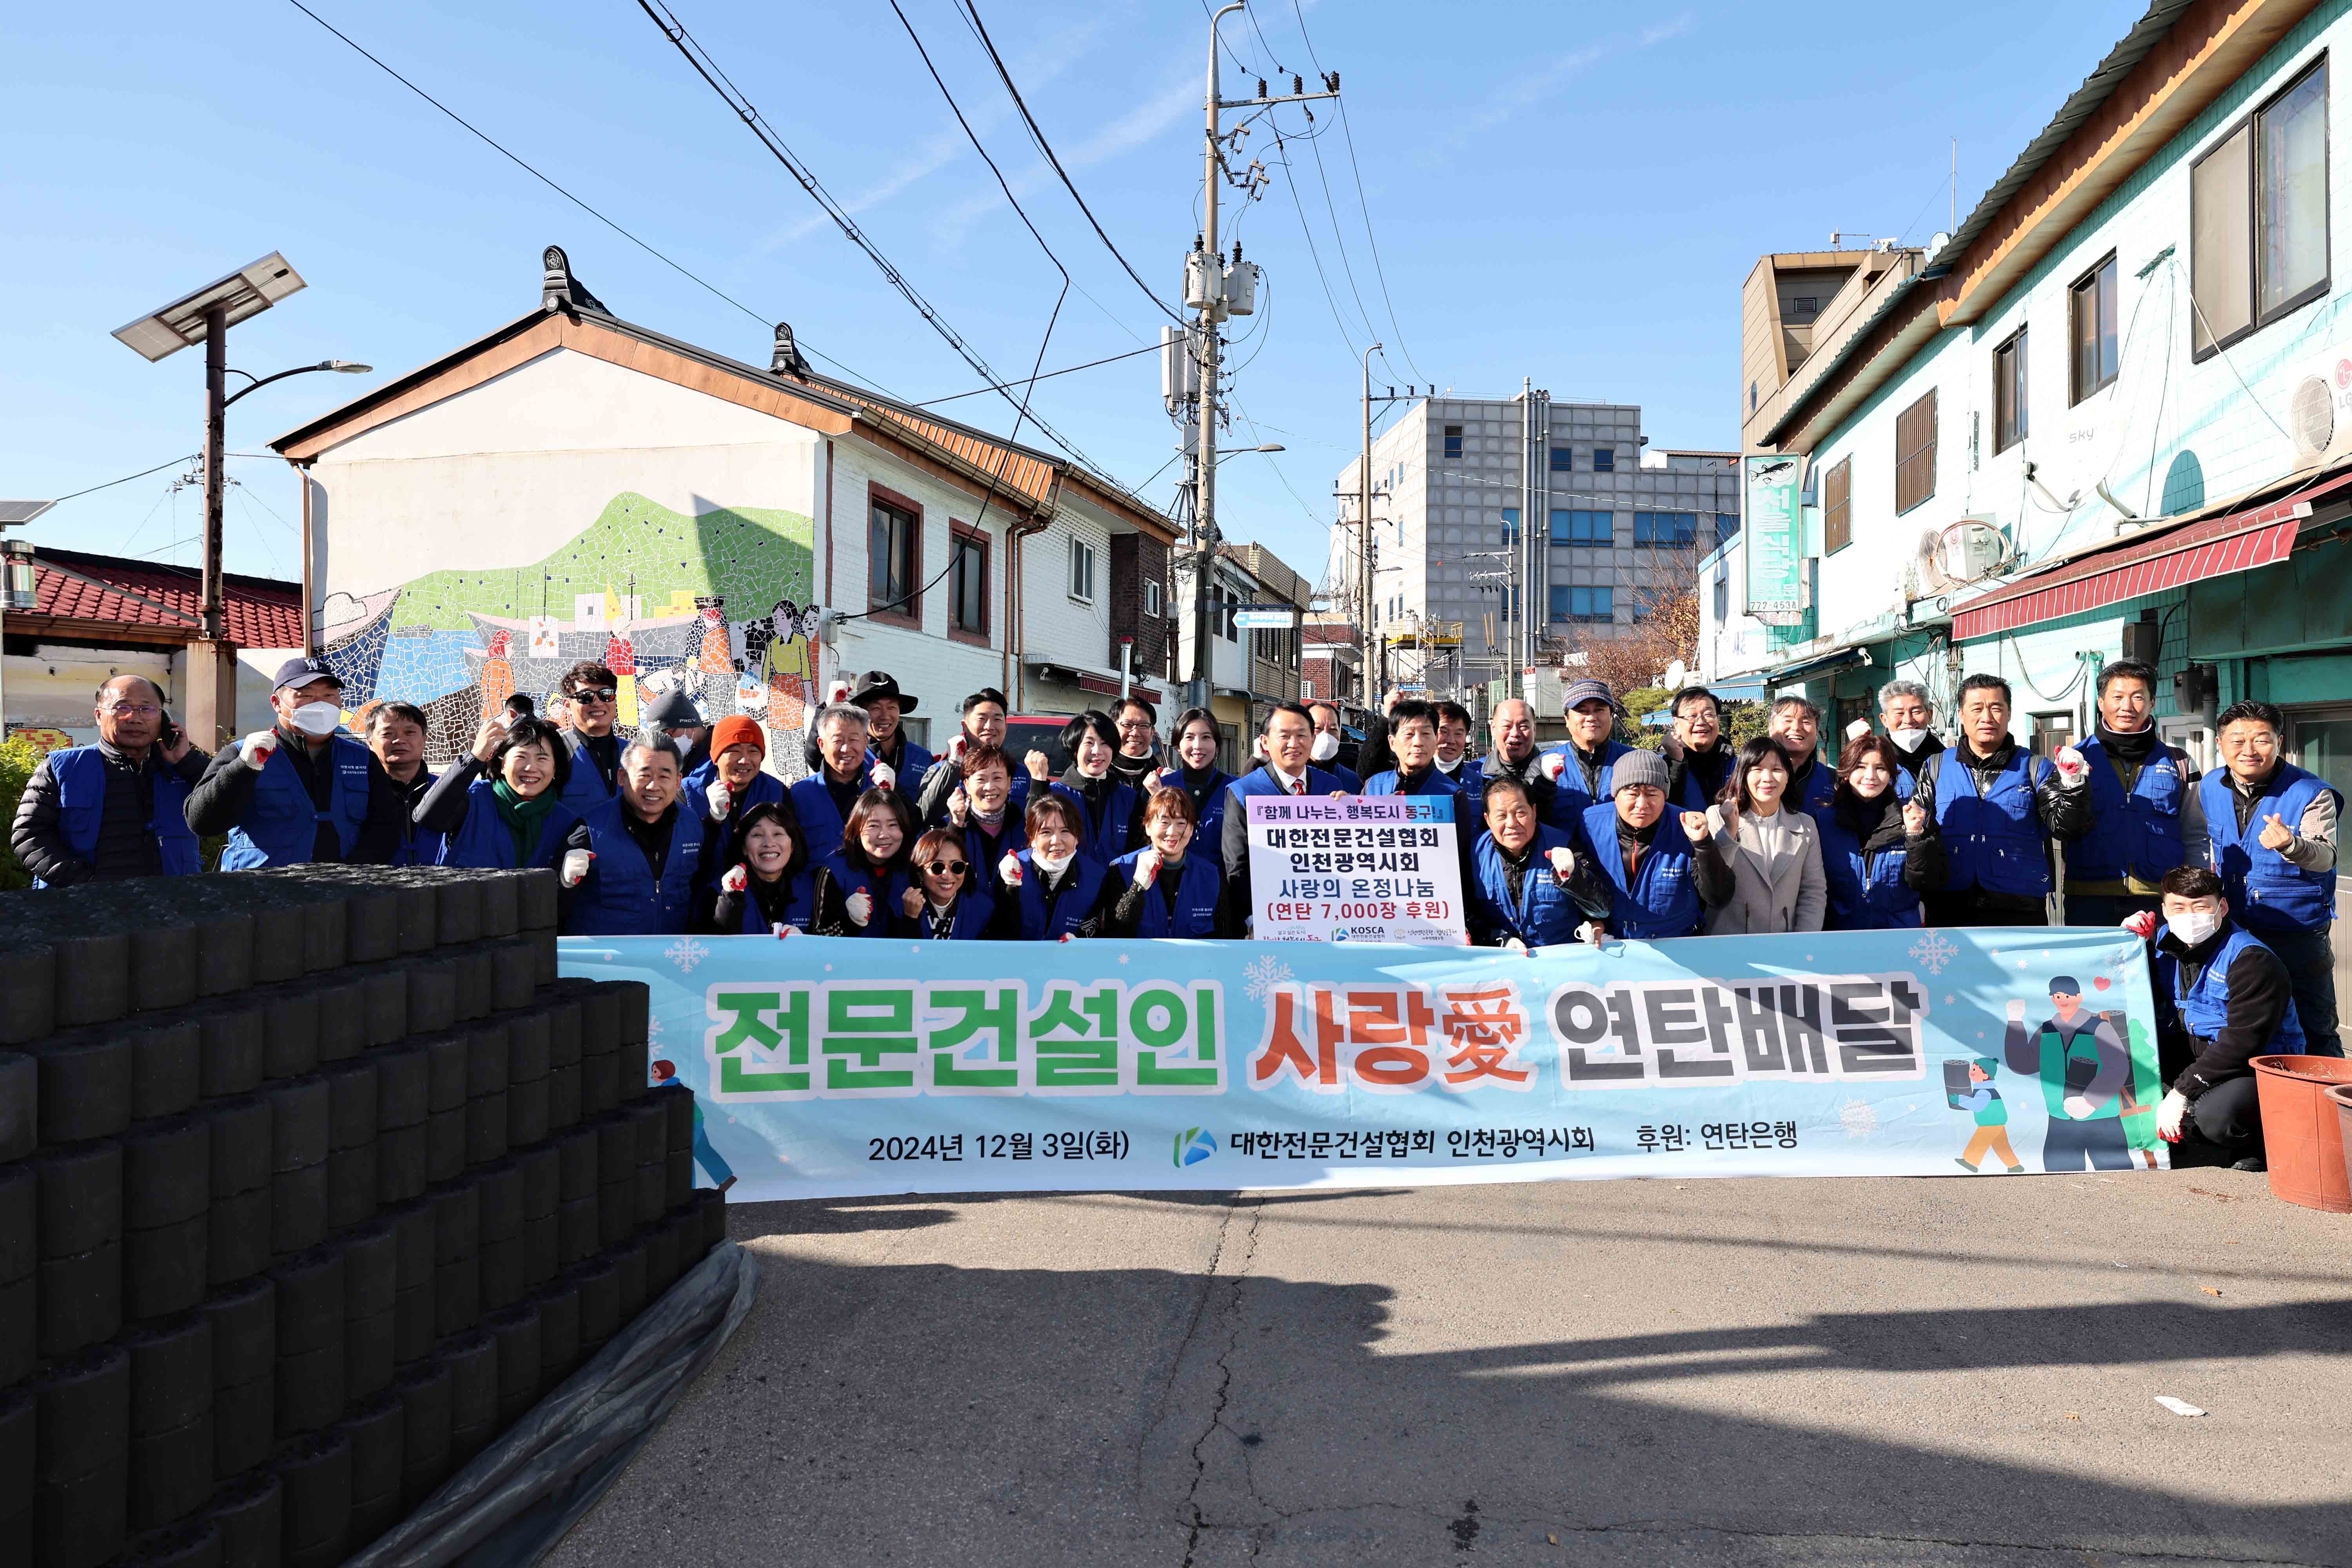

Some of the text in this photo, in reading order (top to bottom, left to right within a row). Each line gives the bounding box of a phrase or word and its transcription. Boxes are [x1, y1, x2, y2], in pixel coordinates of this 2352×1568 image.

[1755, 488, 1794, 579] 서울식당
[1296, 805, 1342, 820] 나누는,
[1347, 805, 1400, 819] 행복도시
[1267, 828, 1439, 848] 대한전문건설협회
[1290, 852, 1419, 873] 인천광역시회
[1279, 878, 1435, 898] 사랑의 온정나눔
[1268, 901, 1449, 921] (연탄 7,000장 후원)
[716, 981, 1920, 1093] 전문건설인 사랑愛 연탄배달
[868, 1121, 1798, 1161] 2024년 12월 3일(화) 대한전문건설협회 인천광역시회 후원: 연탄은행
